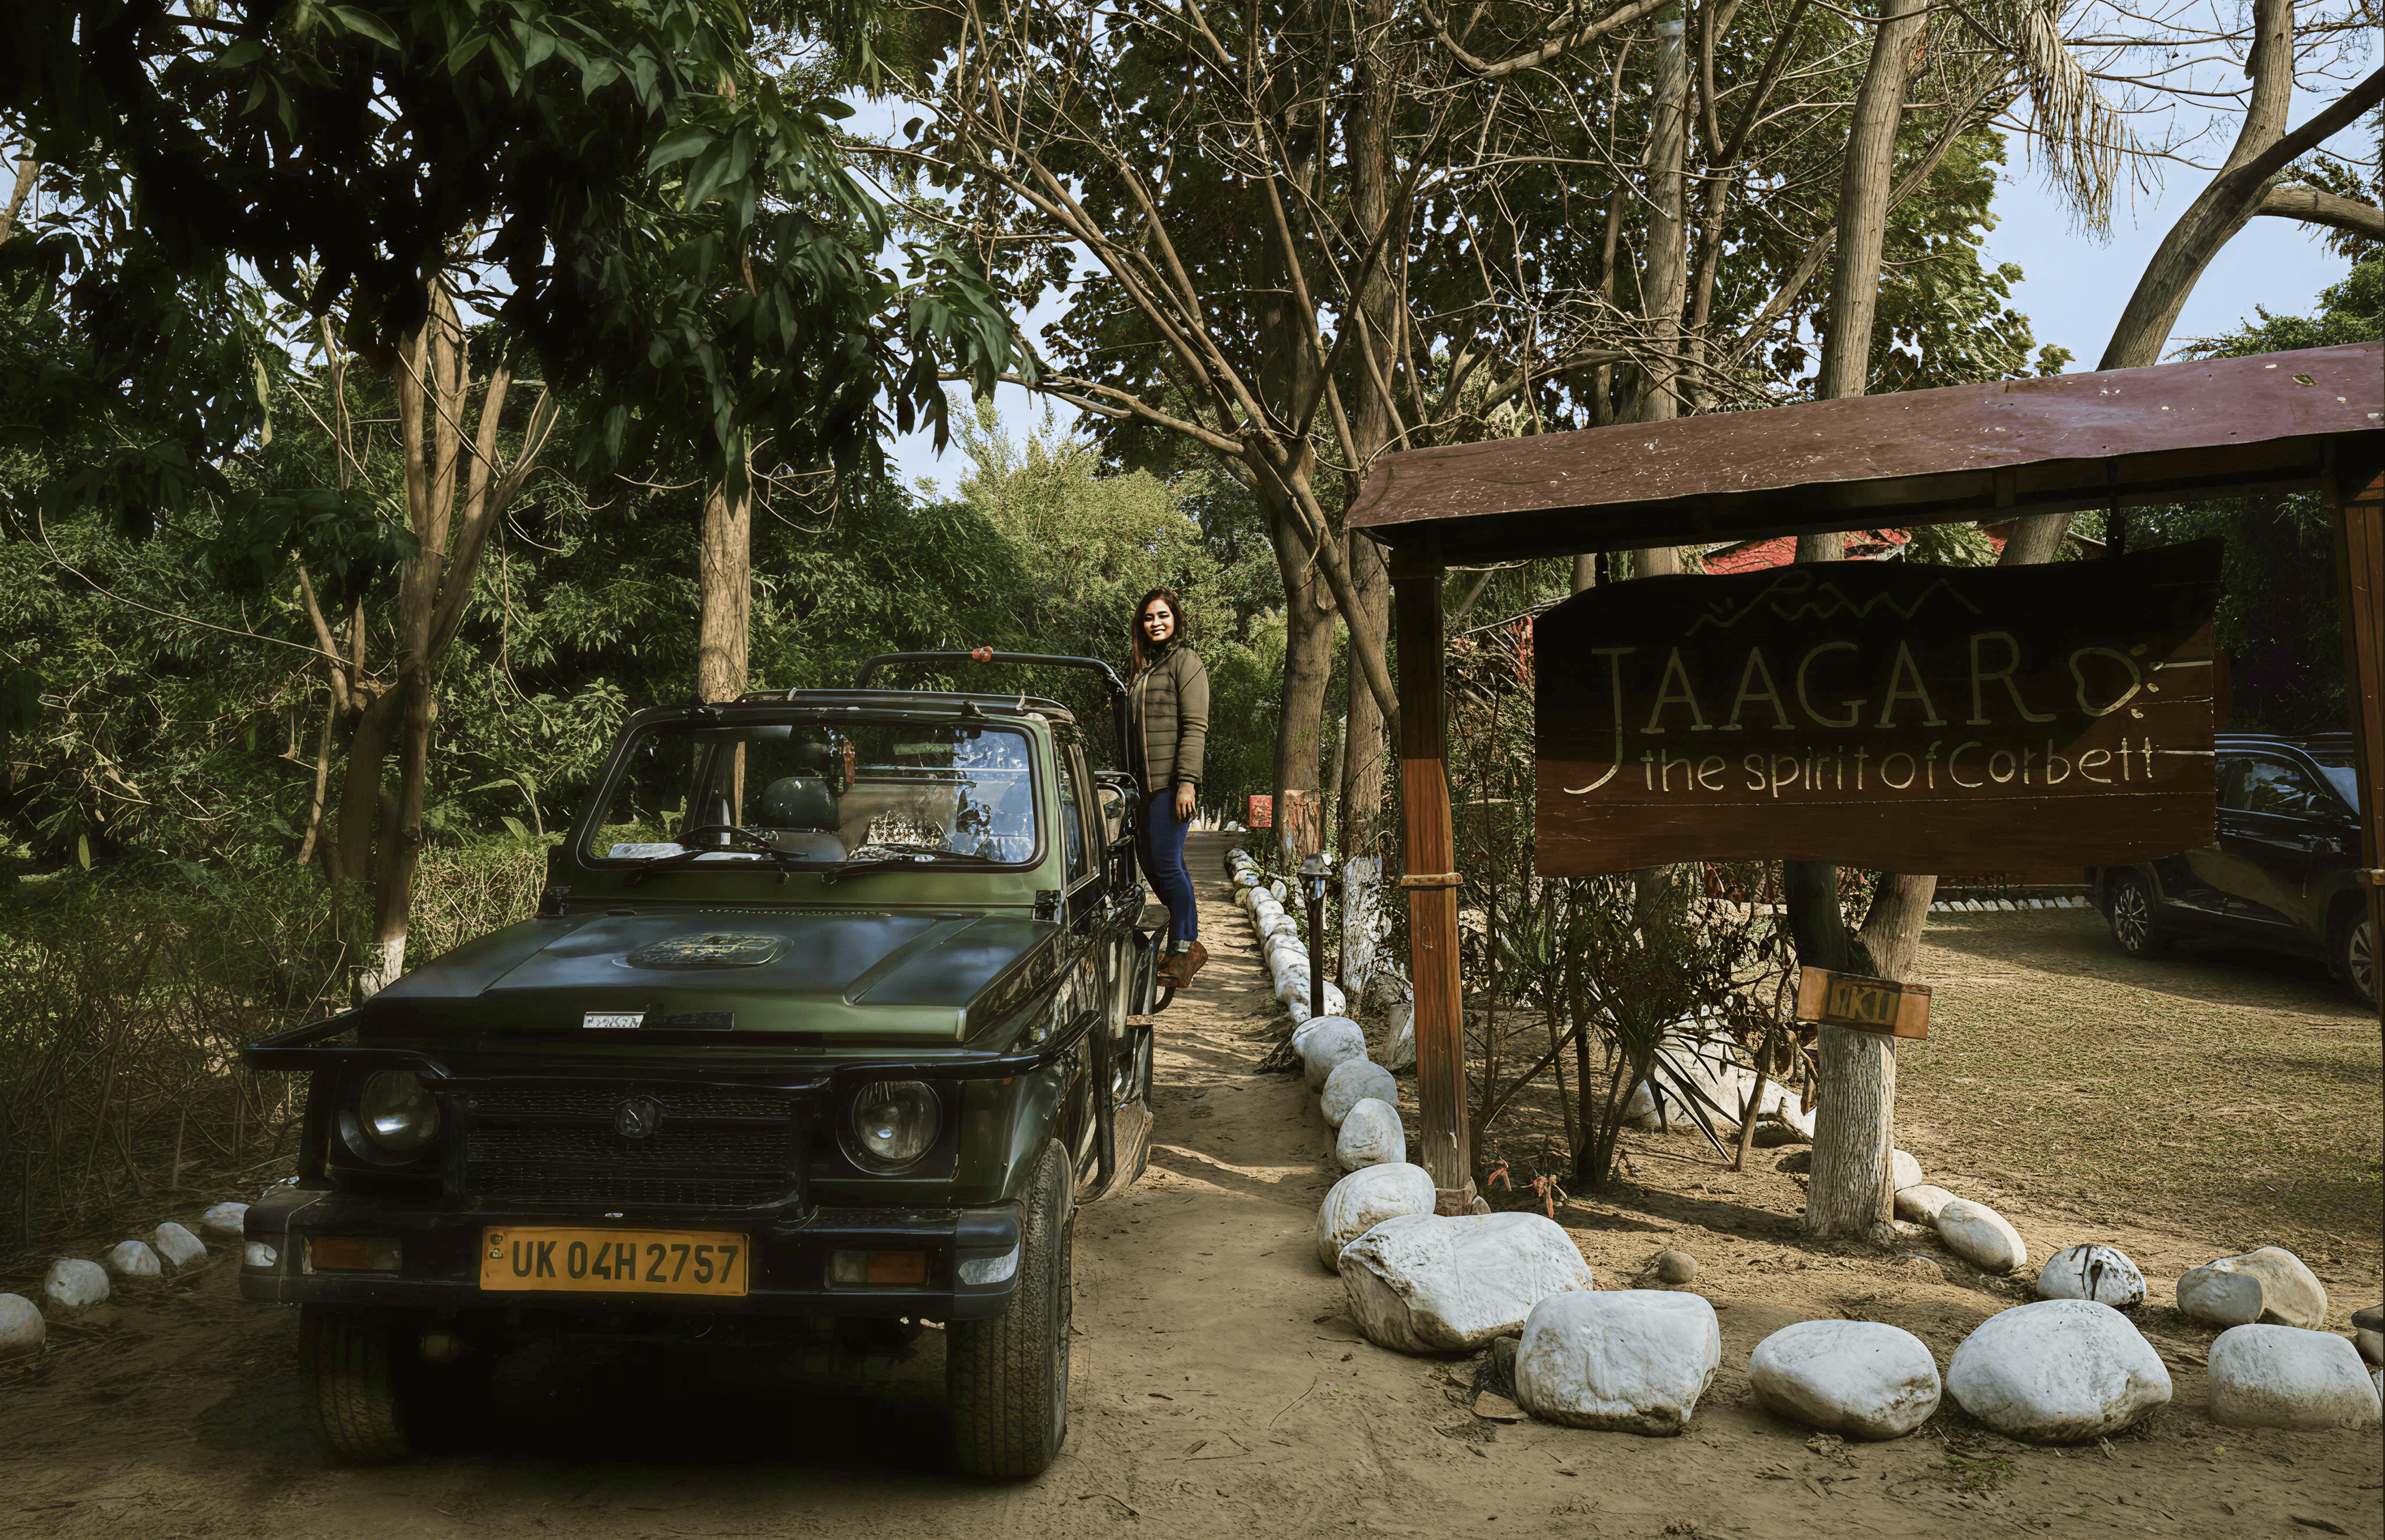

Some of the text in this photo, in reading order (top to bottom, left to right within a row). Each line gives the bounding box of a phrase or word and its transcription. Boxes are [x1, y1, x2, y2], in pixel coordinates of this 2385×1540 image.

[1640, 737, 2156, 798] the spirit of Corbett
[512, 1240, 739, 1284] UK 04H 2757
